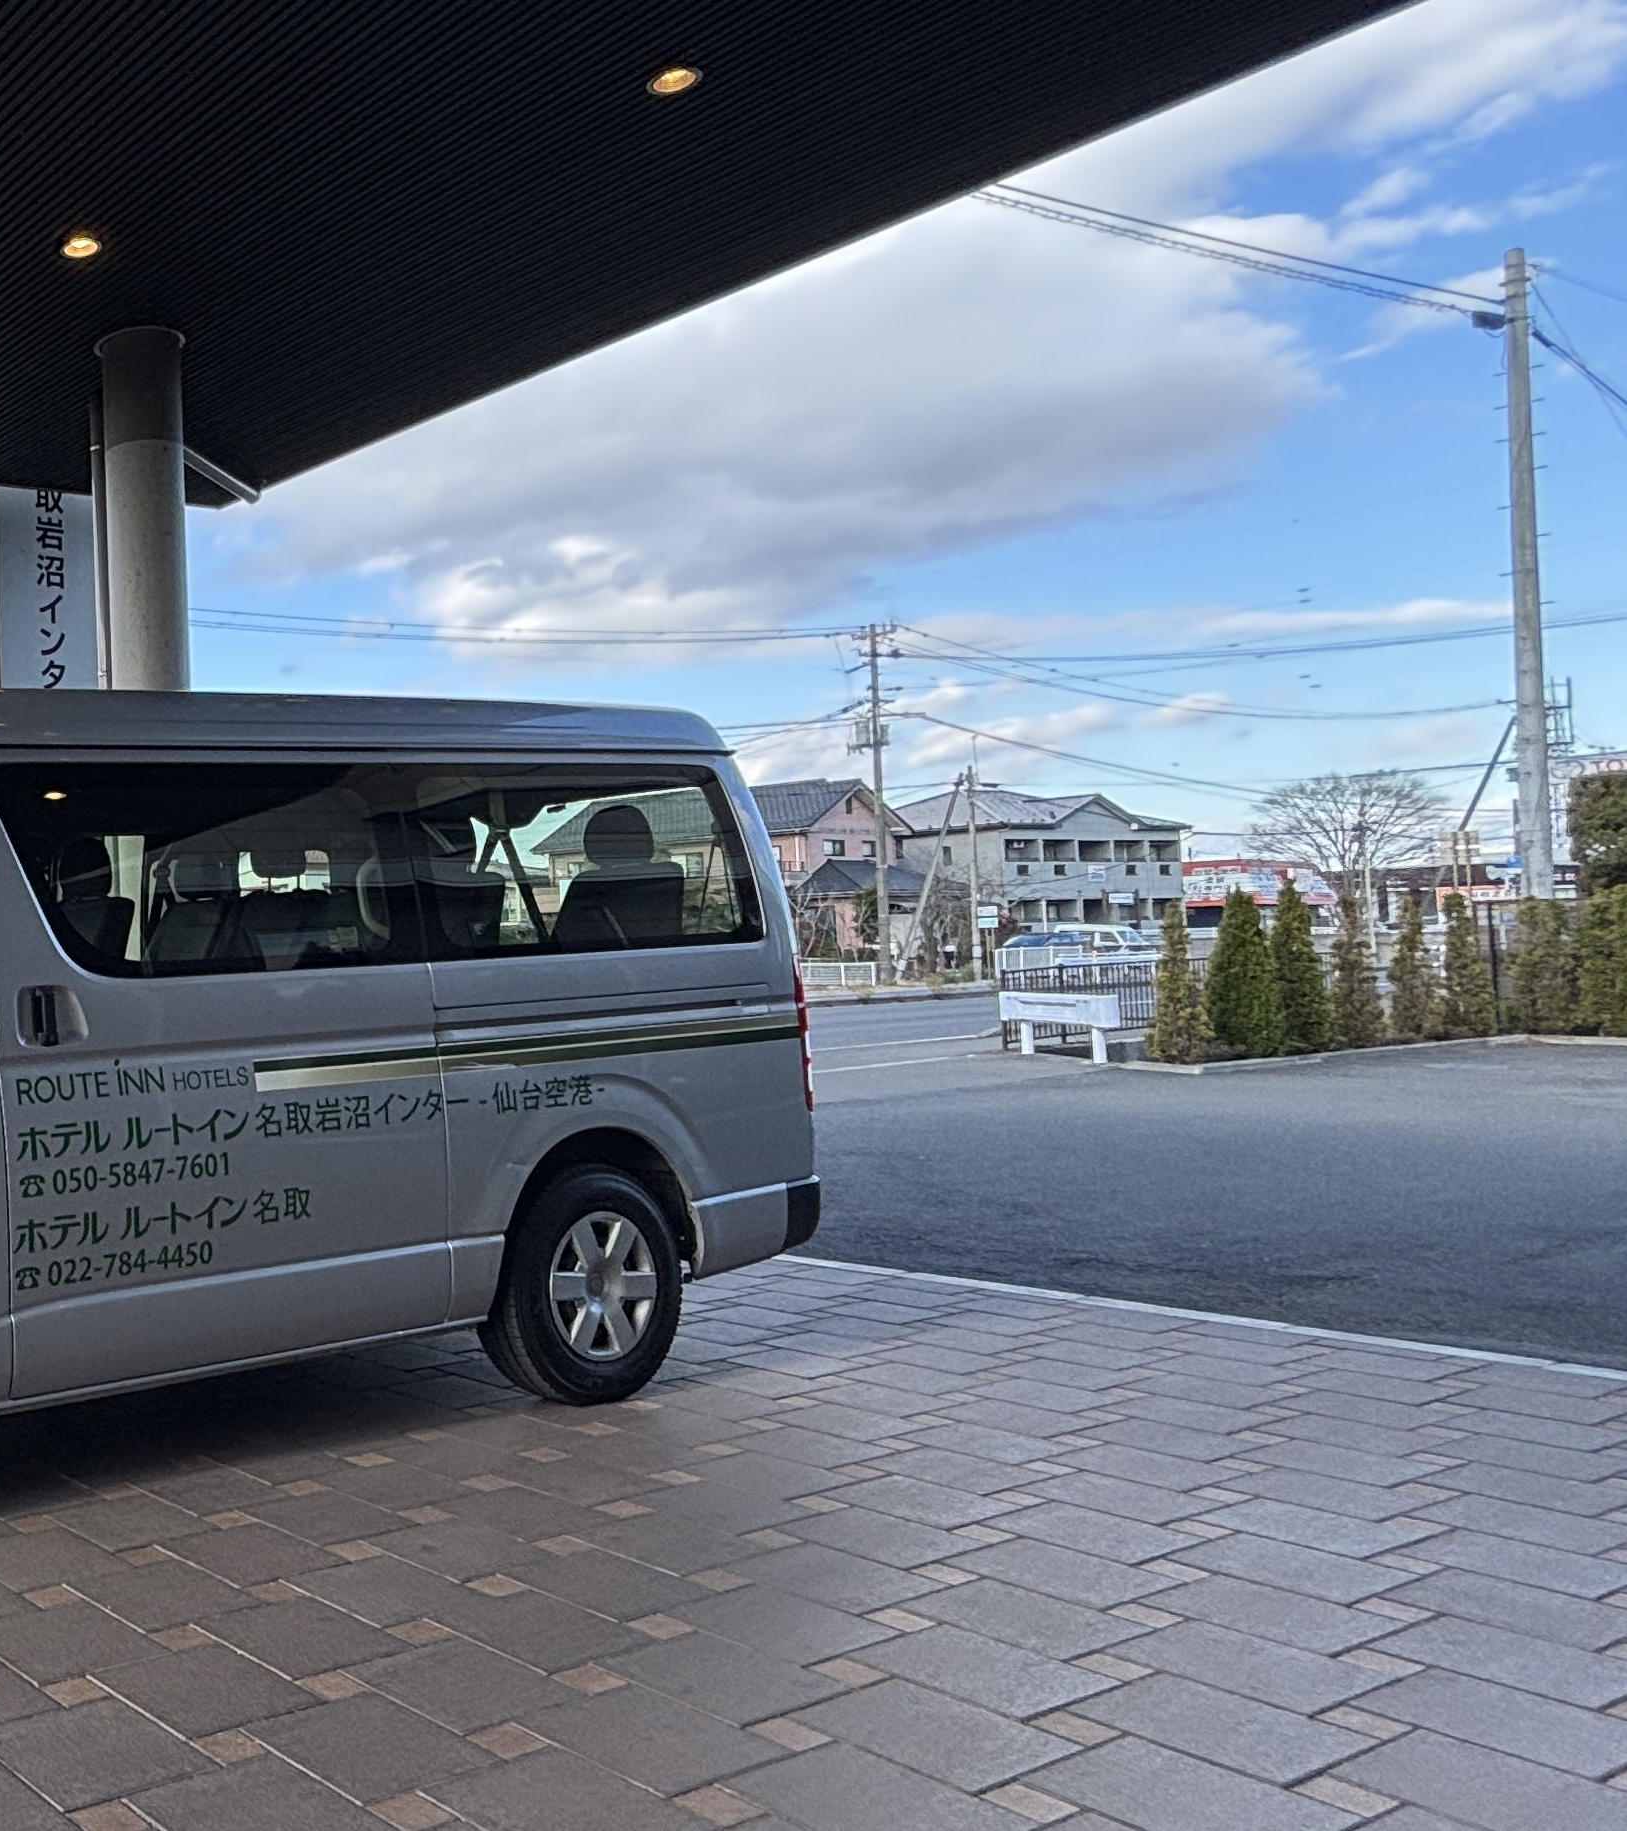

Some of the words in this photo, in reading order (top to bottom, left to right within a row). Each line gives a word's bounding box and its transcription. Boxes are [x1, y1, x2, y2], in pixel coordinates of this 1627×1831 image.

[15, 1070, 110, 1105] ROUTE
[172, 1066, 250, 1091] HOTELS
[16, 1120, 111, 1162] ホテル
[52, 1152, 230, 1195] 050-5847-7601
[13, 1211, 110, 1254] ホテル
[47, 1240, 214, 1287] 022-784-4450
